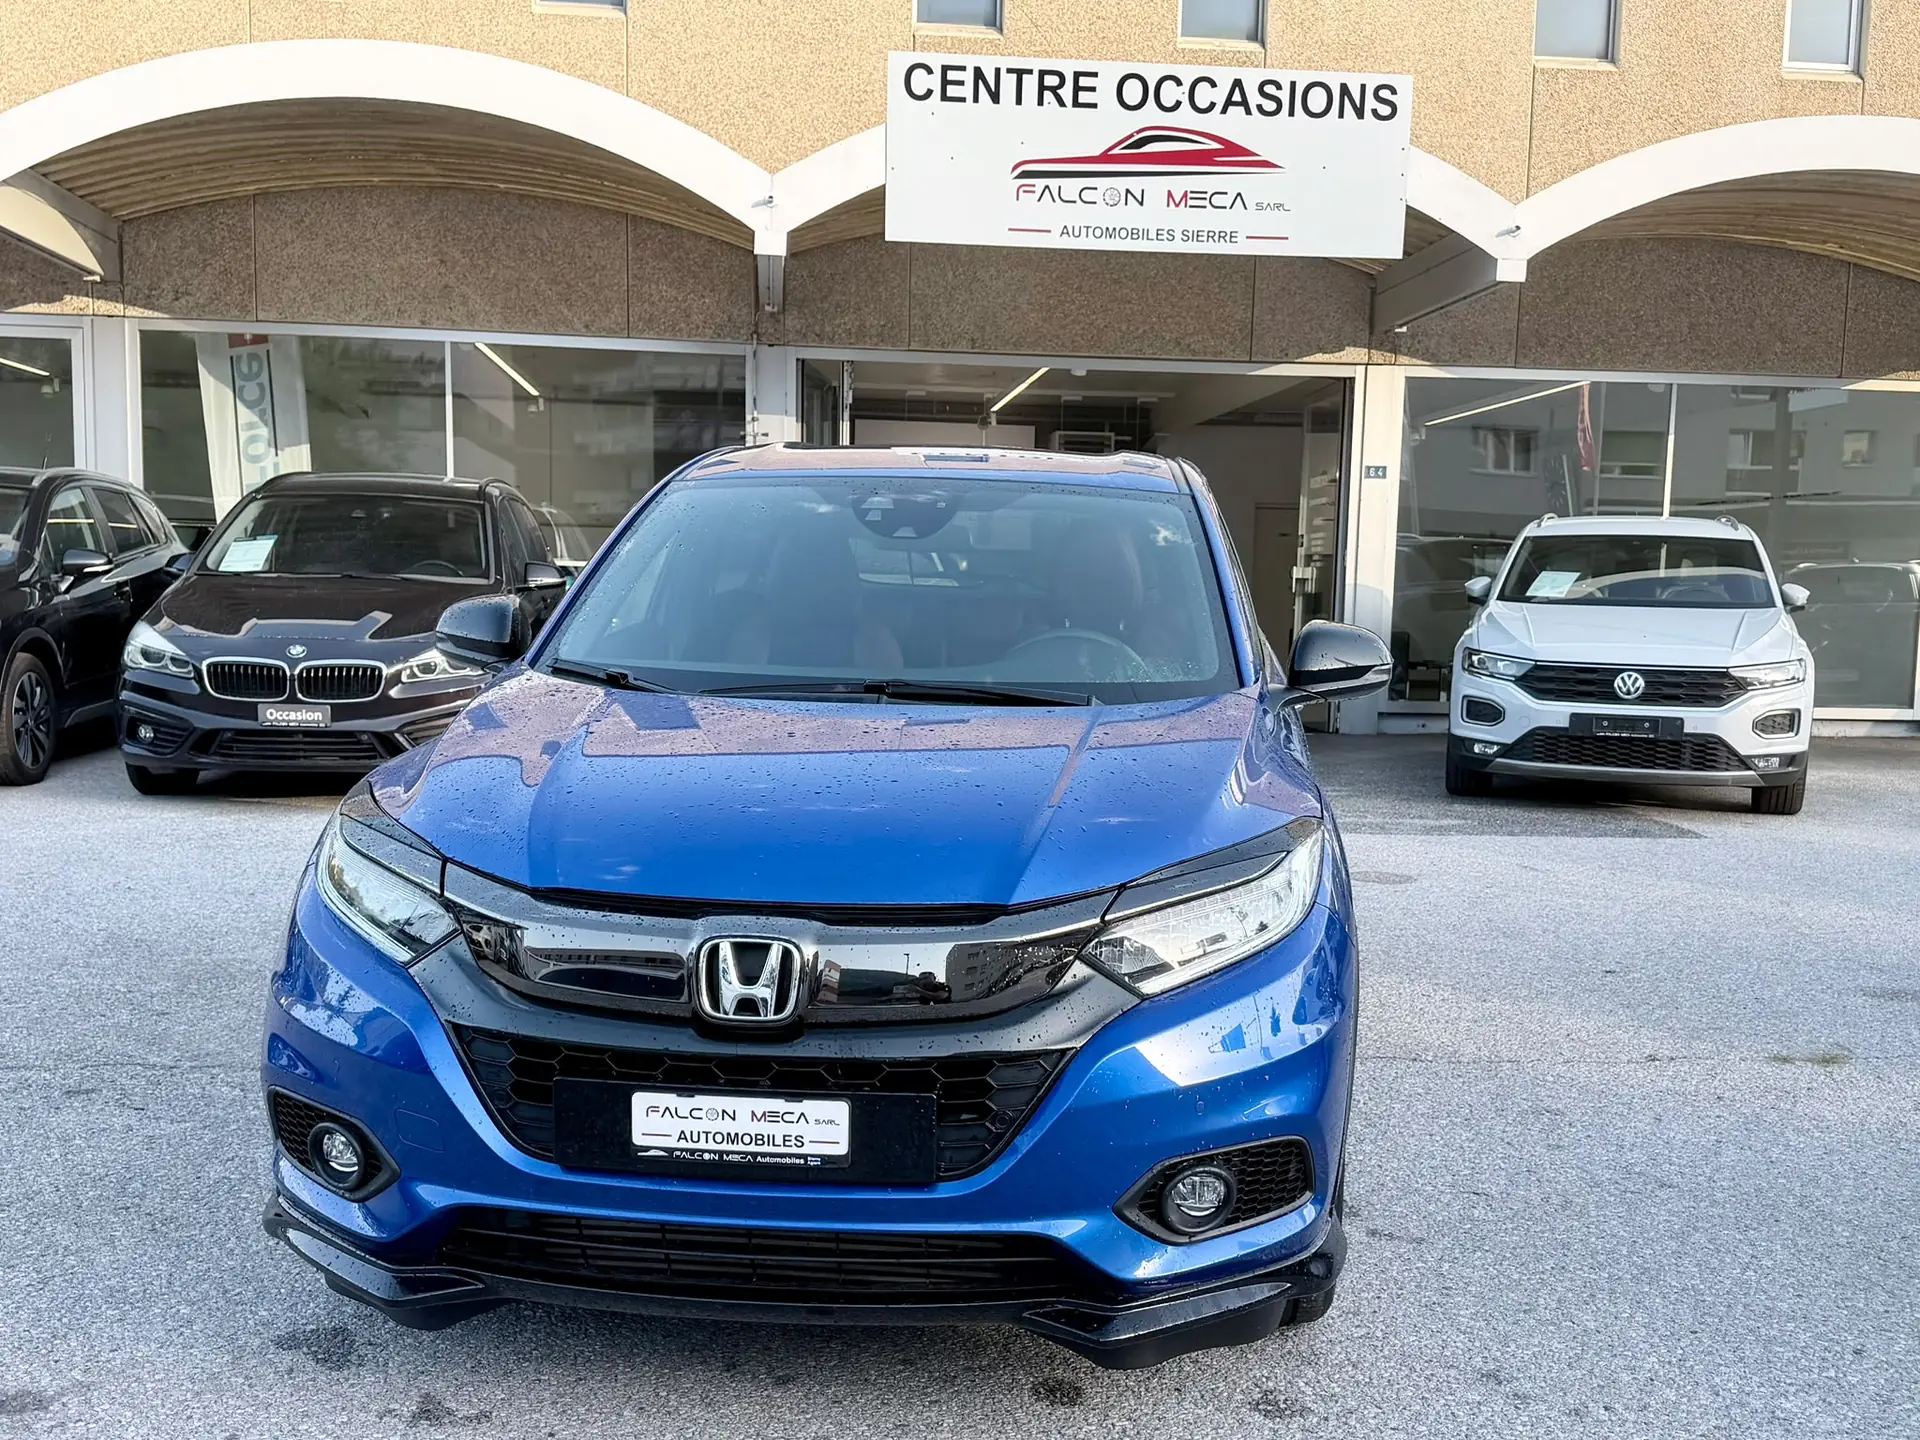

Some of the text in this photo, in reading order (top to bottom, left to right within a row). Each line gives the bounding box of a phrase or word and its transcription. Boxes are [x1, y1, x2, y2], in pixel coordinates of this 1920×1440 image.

[904, 62, 1398, 121] CENTRE OCCASIONS
[1016, 184, 1291, 212] FALCON MECA SARL
[1060, 225, 1239, 244] AUTOMOBILES SIERRE
[266, 708, 322, 721] Occasion
[646, 1106, 736, 1122] FALCON
[751, 1110, 809, 1125] MECA
[676, 1130, 805, 1148] AUTOMOBILES
[673, 1151, 719, 1161] FALCON
[723, 1153, 753, 1162] MECA
[756, 1156, 805, 1165] Automobiles
